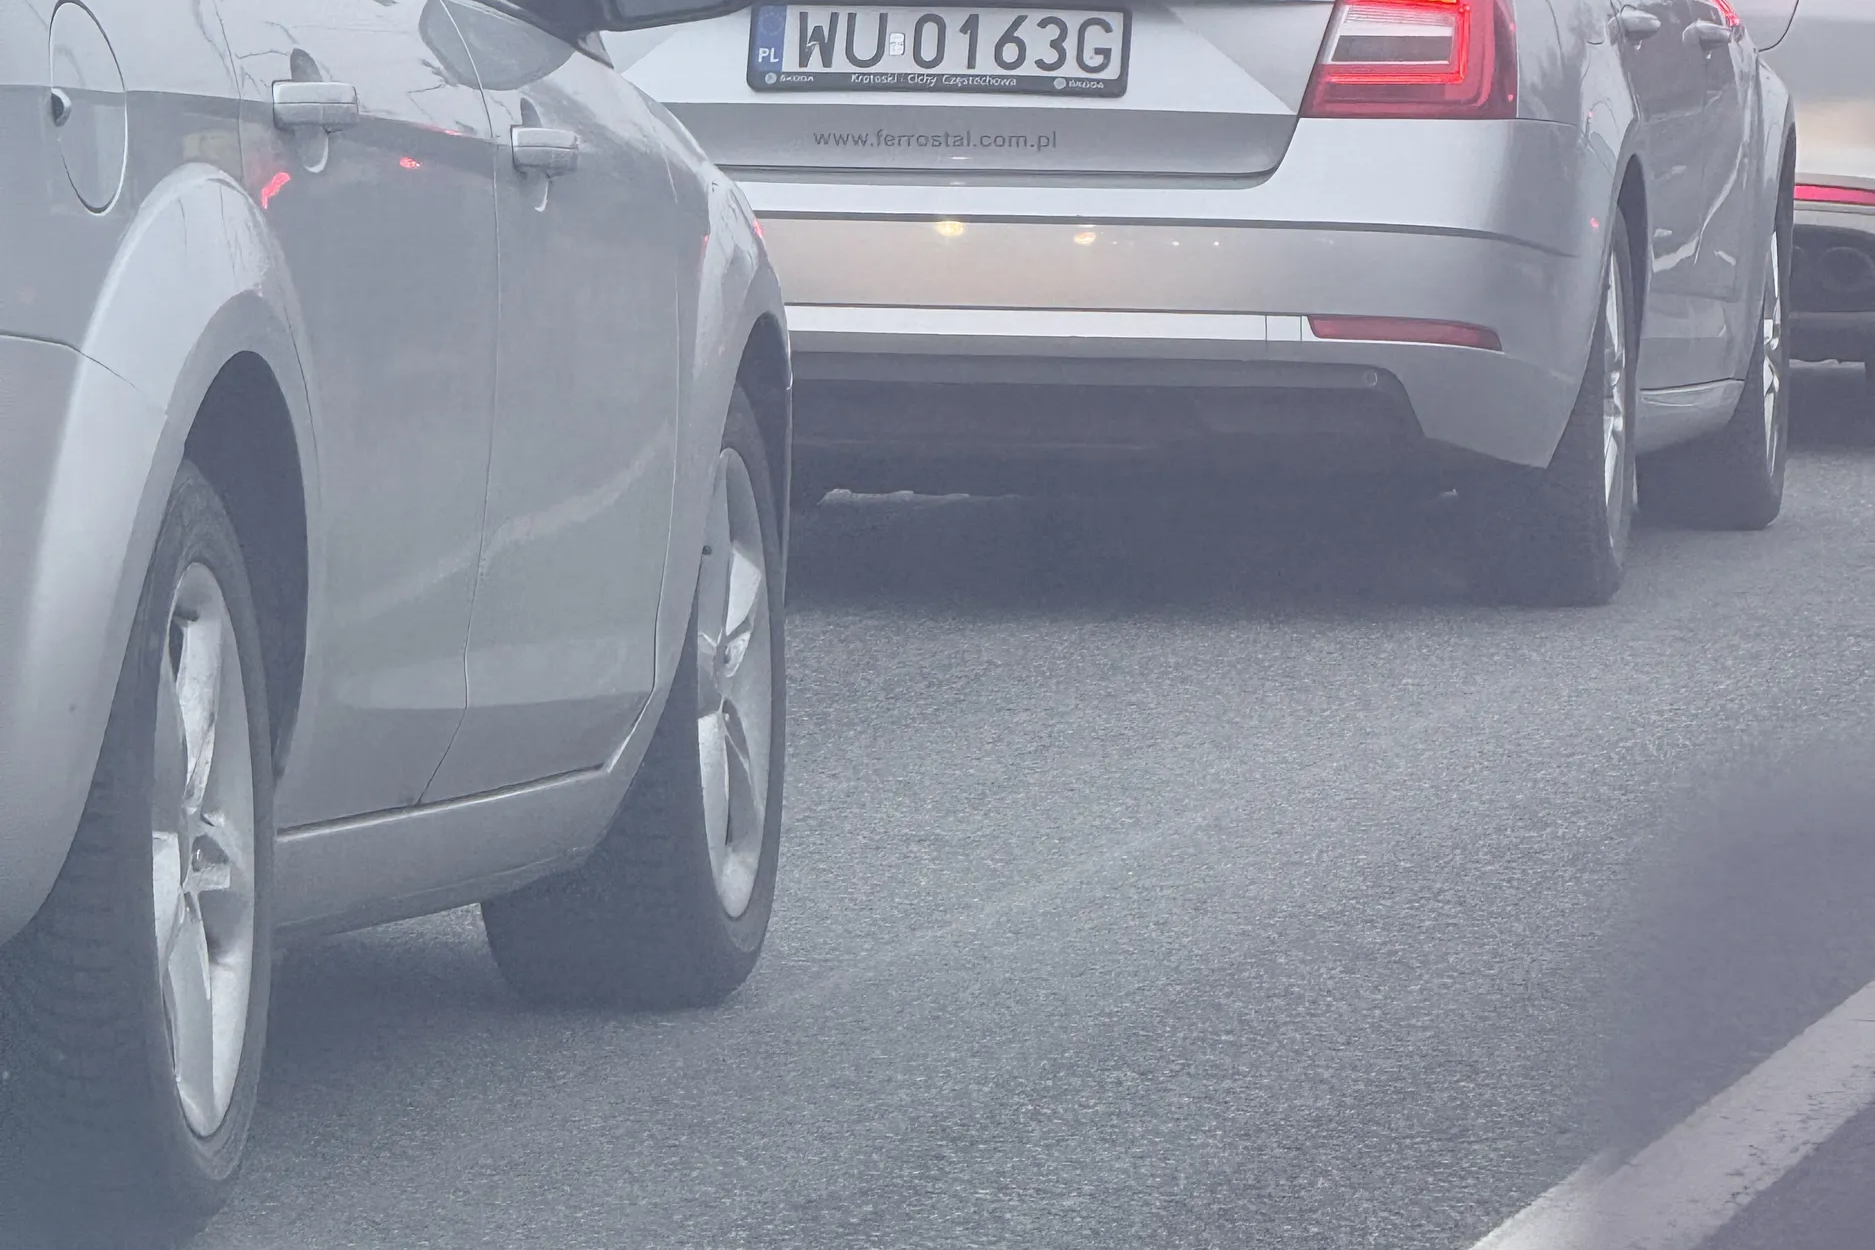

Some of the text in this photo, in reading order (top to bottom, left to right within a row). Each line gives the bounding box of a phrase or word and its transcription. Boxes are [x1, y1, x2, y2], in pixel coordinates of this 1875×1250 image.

[798, 11, 889, 68] WU
[913, 13, 1114, 73] 0163G
[758, 47, 779, 63] PL
[813, 128, 1057, 151] www.ferrostal.com.pl
